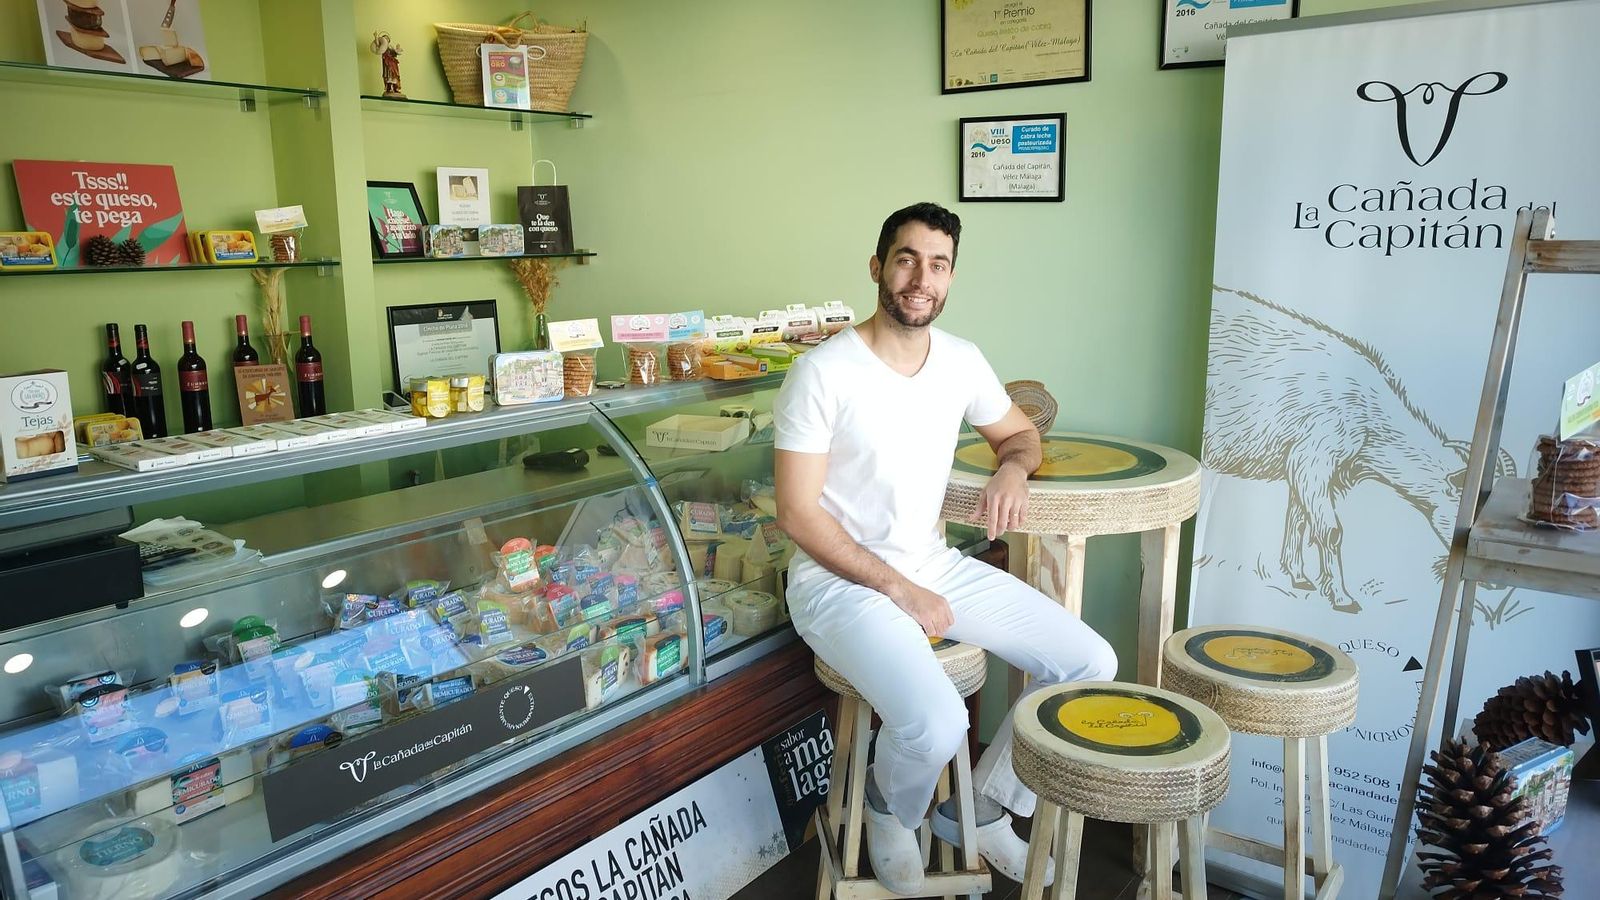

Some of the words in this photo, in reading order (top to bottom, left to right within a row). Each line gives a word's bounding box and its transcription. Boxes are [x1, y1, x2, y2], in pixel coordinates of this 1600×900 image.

[1004, 6, 1036, 18] Premio
[1176, 8, 1196, 17] 2016
[988, 45, 998, 54] del
[993, 163, 1015, 171] Cañada
[72, 171, 129, 191] Tsss!!
[1002, 173, 1018, 181] Vélez
[1019, 173, 1042, 181] Málaga
[1009, 183, 1036, 191] (Málaga)
[51, 190, 92, 206] este
[96, 193, 157, 211] queso,
[1292, 202, 1319, 230] La
[1327, 177, 1506, 213] Cañada
[73, 207, 92, 224] te
[96, 209, 143, 228] pega
[536, 213, 550, 221] Que
[1324, 215, 1503, 256] Capitán
[21, 415, 54, 429] Tejas
[411, 590, 438, 602] CURADO
[439, 595, 463, 608] CURADO
[368, 607, 401, 619] CURADO
[482, 614, 507, 626] CURADO
[1338, 639, 1400, 658] QUESO
[373, 758, 382, 771] La
[382, 744, 424, 767] Cañada
[434, 721, 473, 746] Capitán
[781, 728, 805, 751] sabor
[784, 751, 793, 765] a
[1251, 777, 1271, 790] Pol.
[1334, 766, 1360, 781] 952
[1363, 774, 1390, 789] 508
[1341, 802, 1363, 816] Las
[95, 836, 143, 860] TIERNO
[591, 849, 626, 894] LA
[625, 800, 708, 872] CAÑADA
